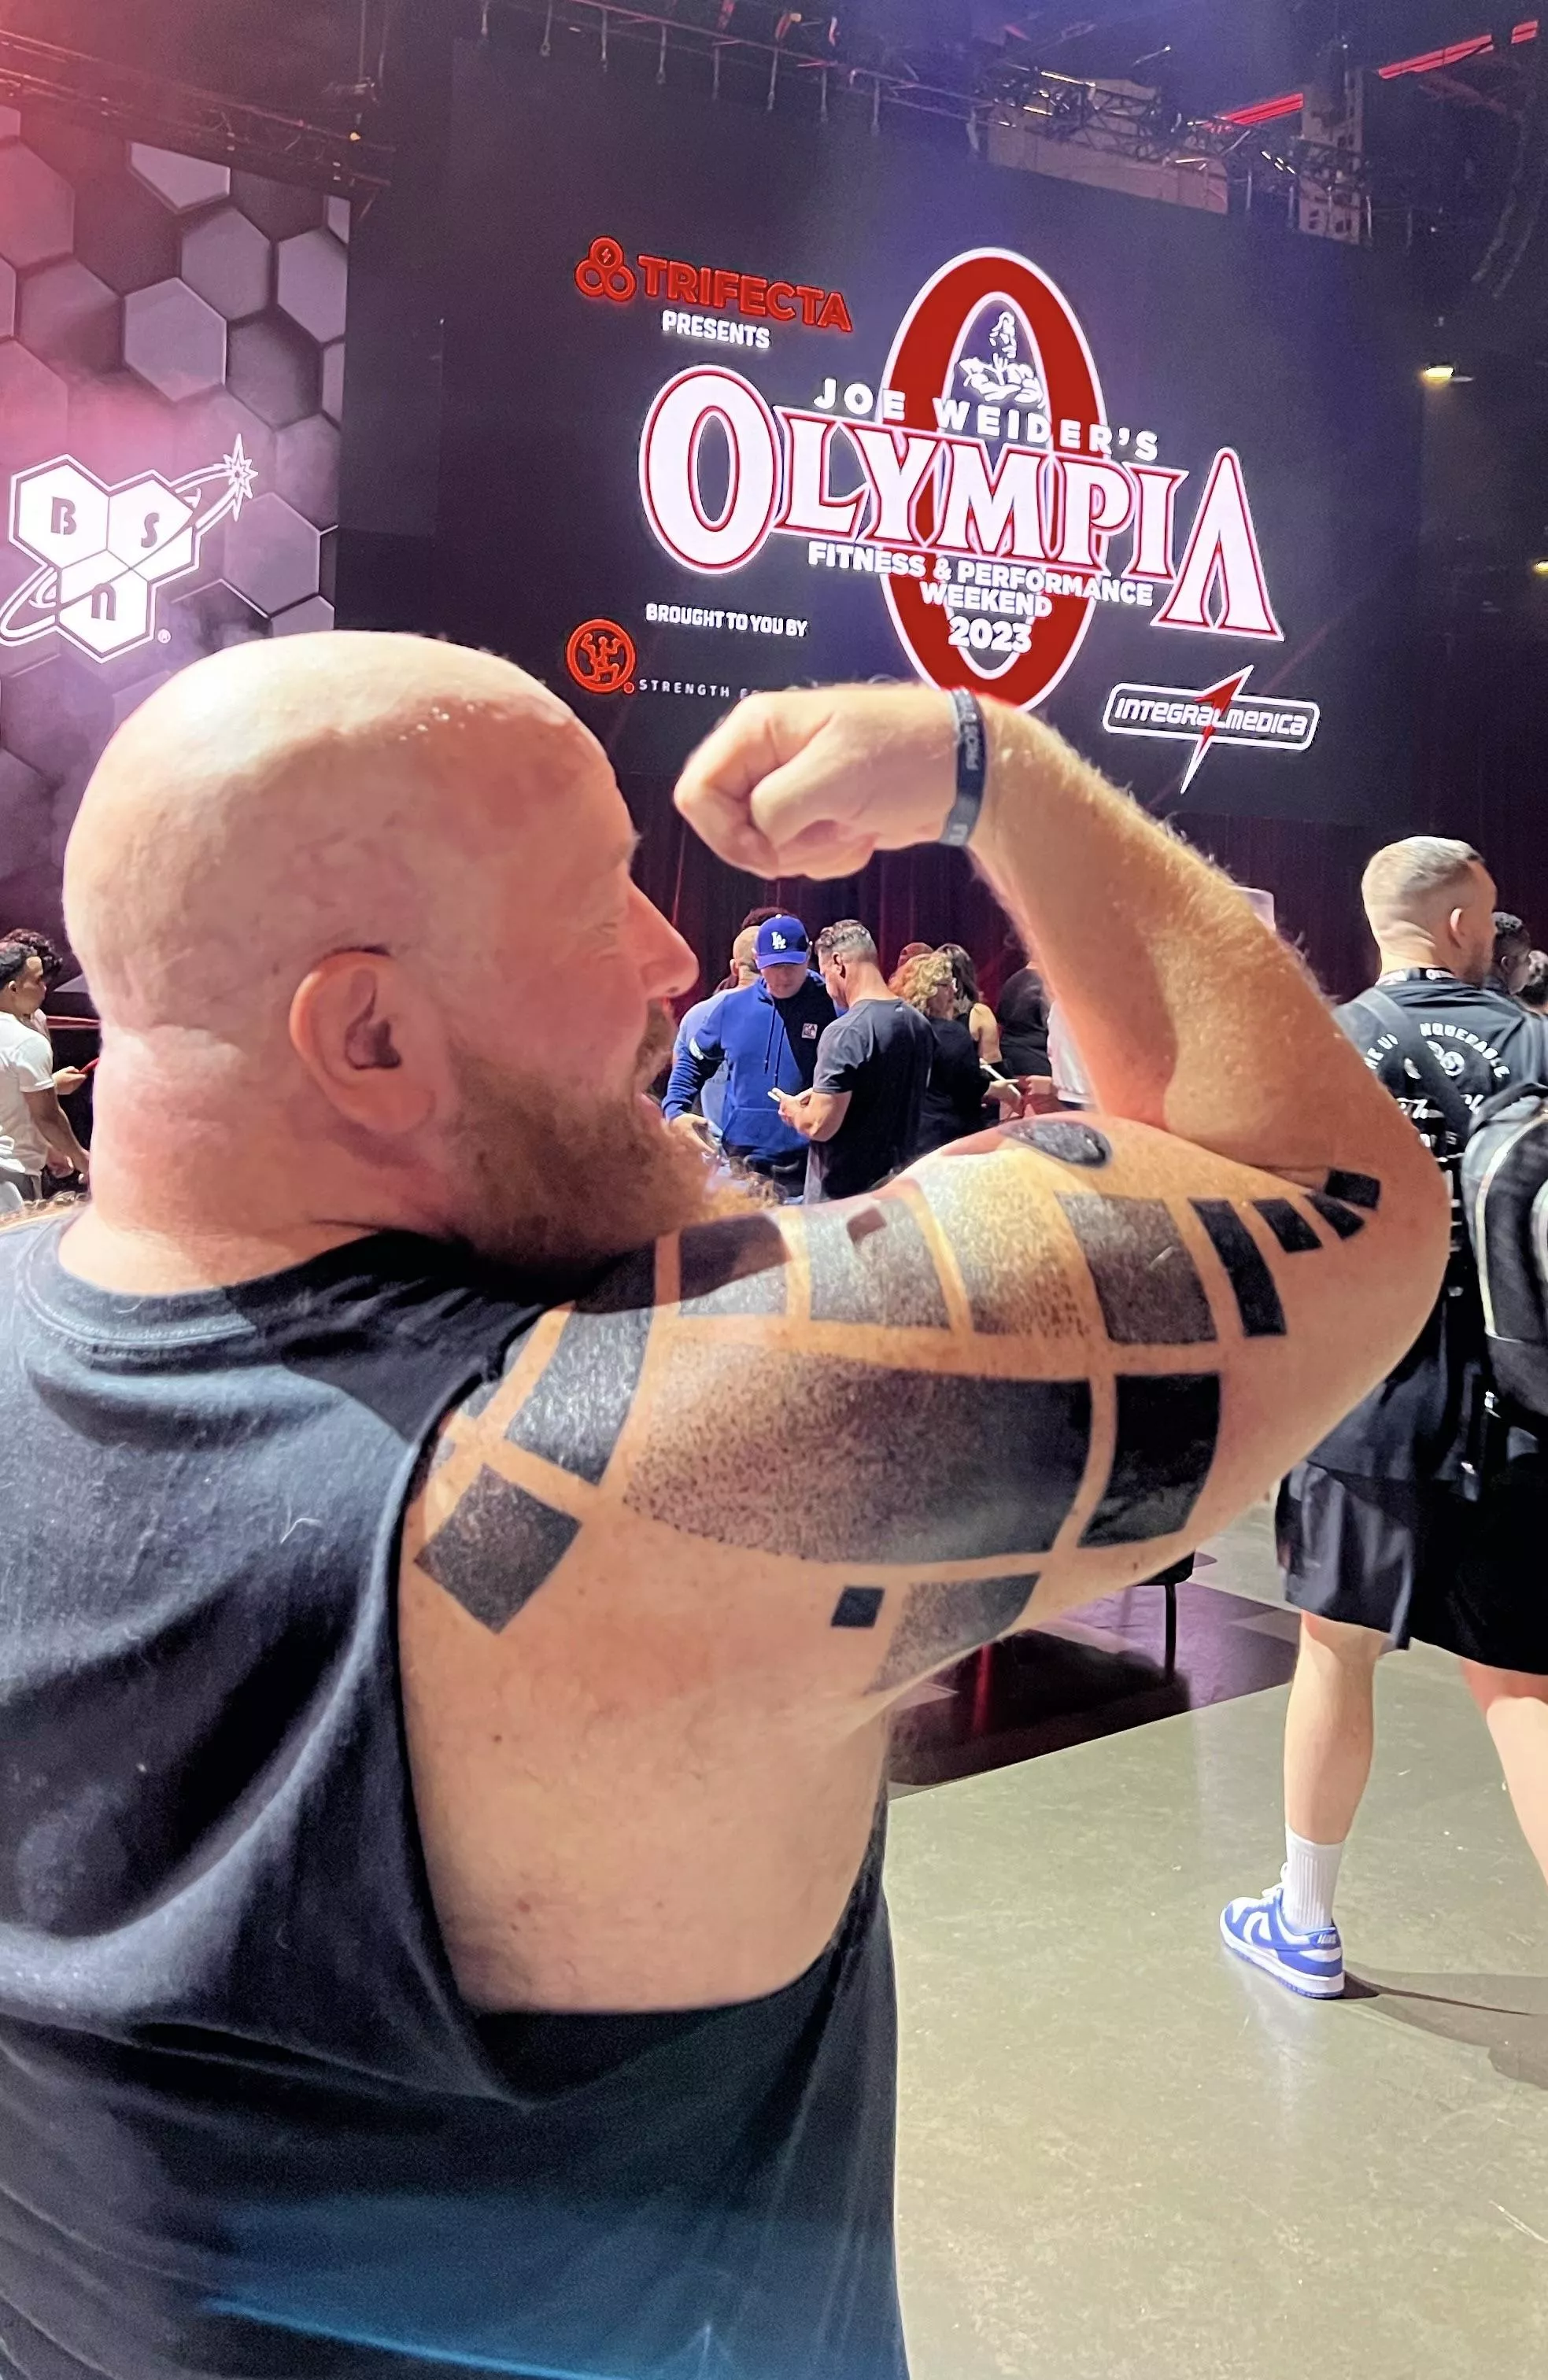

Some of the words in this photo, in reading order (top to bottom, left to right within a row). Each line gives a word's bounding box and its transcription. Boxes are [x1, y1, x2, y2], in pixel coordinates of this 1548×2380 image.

[637, 254, 853, 332] TRIFECTA
[662, 310, 770, 349] PRESENTS
[813, 378, 906, 420] JOE
[933, 396, 1158, 463] WEIDER'S
[639, 364, 1285, 642] OLYMPIA
[808, 541, 926, 578] FITNESS
[933, 557, 952, 581] &
[957, 559, 1154, 607] PERFORMANCE
[920, 581, 1053, 618] WEEKEND
[646, 603, 725, 628] BROUGHT
[726, 612, 748, 631] TO
[750, 614, 784, 634] YOU
[785, 618, 807, 637] BY
[948, 616, 1033, 653] 2023
[639, 679, 730, 698] STRENGTH
[771, 932, 786, 950] LA
